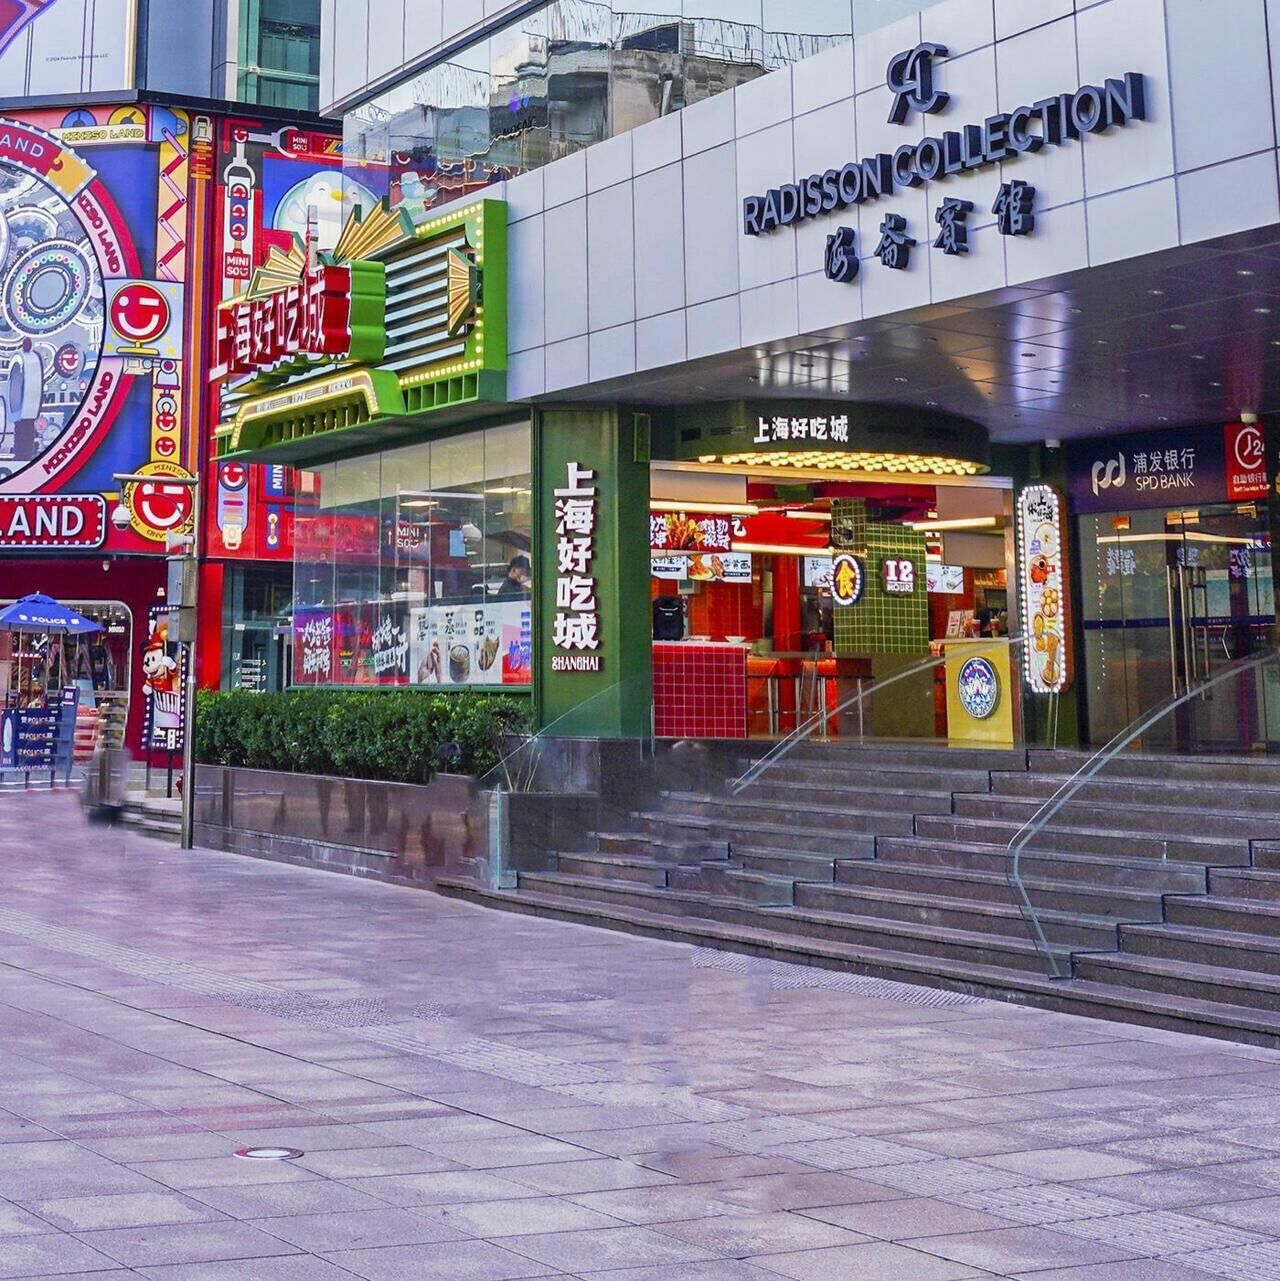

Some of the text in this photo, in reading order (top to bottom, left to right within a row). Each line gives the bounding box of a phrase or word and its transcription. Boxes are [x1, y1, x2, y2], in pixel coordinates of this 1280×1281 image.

[62, 127, 144, 141] MINISO LAND
[292, 136, 308, 144] MINI
[743, 72, 1146, 236] RADISSON COLLECTION
[100, 229, 121, 275] LAND
[226, 256, 249, 266] MINI
[42, 371, 114, 475] MINISO LAND
[754, 414, 849, 443] 上海好吃城
[1132, 447, 1196, 474] 浦发银行
[154, 463, 189, 479] MINISO
[1135, 471, 1195, 491] SPD BANK
[397, 527, 420, 537] MINI
[552, 462, 599, 651] 上海好吃城
[886, 560, 914, 582] 12
[886, 581, 914, 593] HOURS
[31, 616, 67, 625] POLICE
